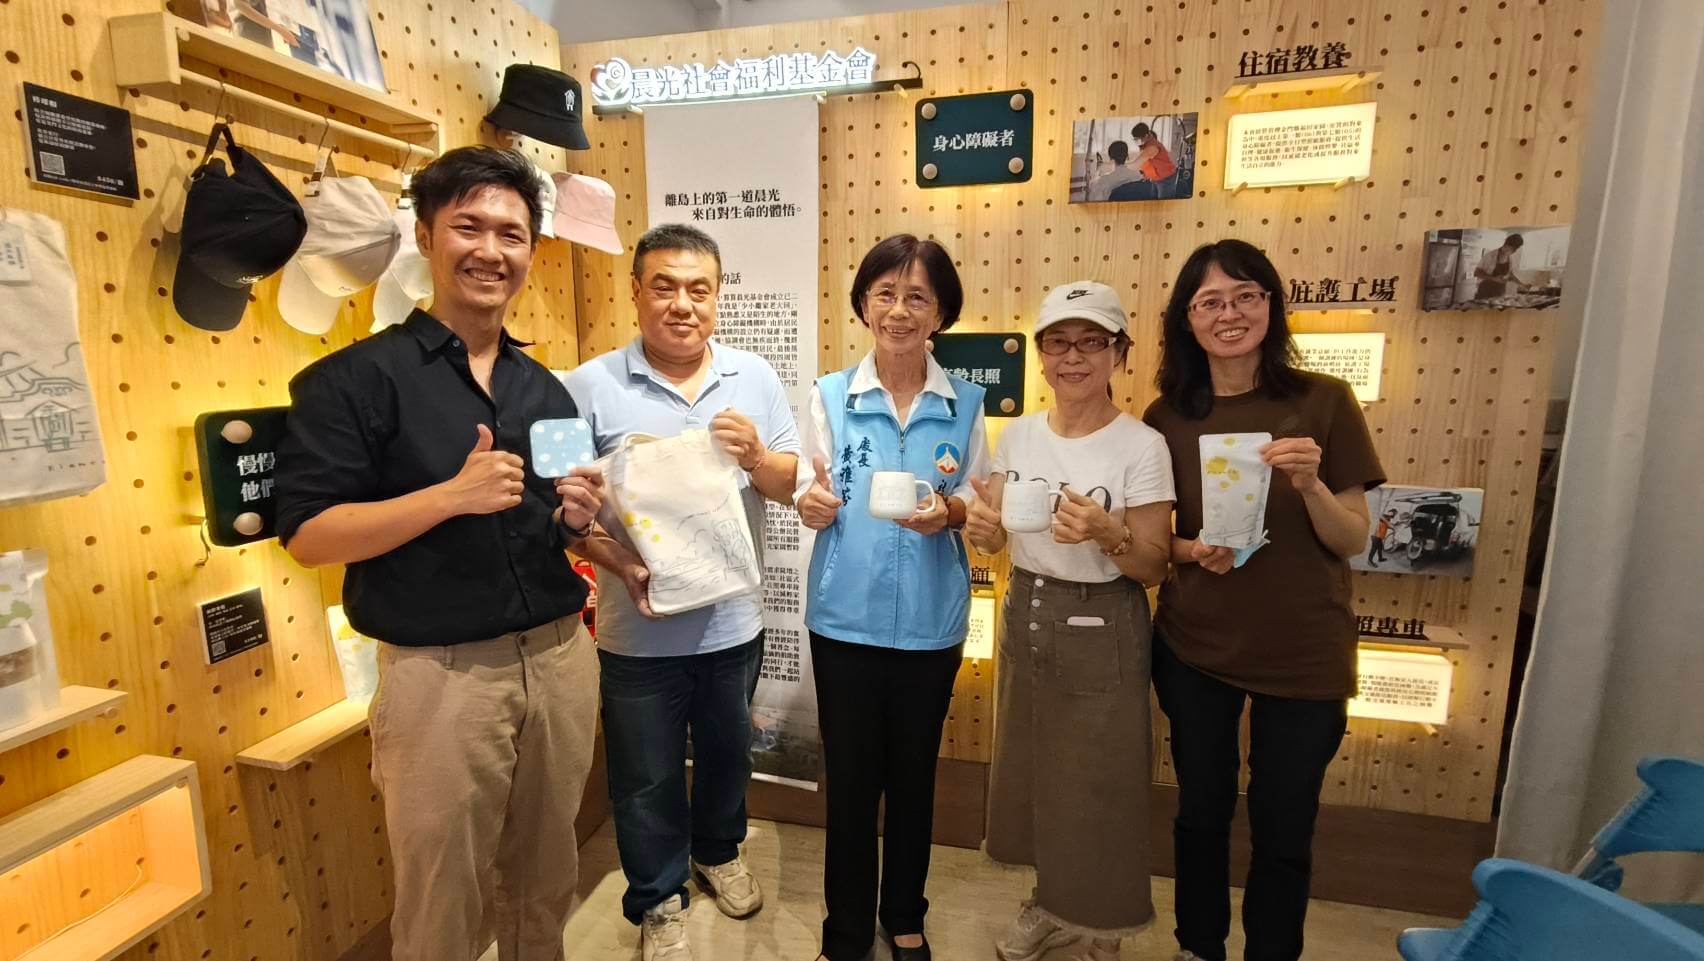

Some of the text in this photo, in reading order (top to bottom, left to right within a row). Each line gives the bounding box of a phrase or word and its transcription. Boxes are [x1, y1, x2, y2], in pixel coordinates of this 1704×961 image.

[1239, 43, 1350, 77] 住宿教養
[630, 49, 874, 98] 晨光社會福利基金會
[932, 130, 1015, 152] 身心障礙者
[664, 189, 782, 208] 離島上的第一道晨光
[691, 202, 802, 221] 來自對生命的體悟。
[1289, 279, 1397, 303] 庇護工場
[237, 452, 276, 476] 慢慢
